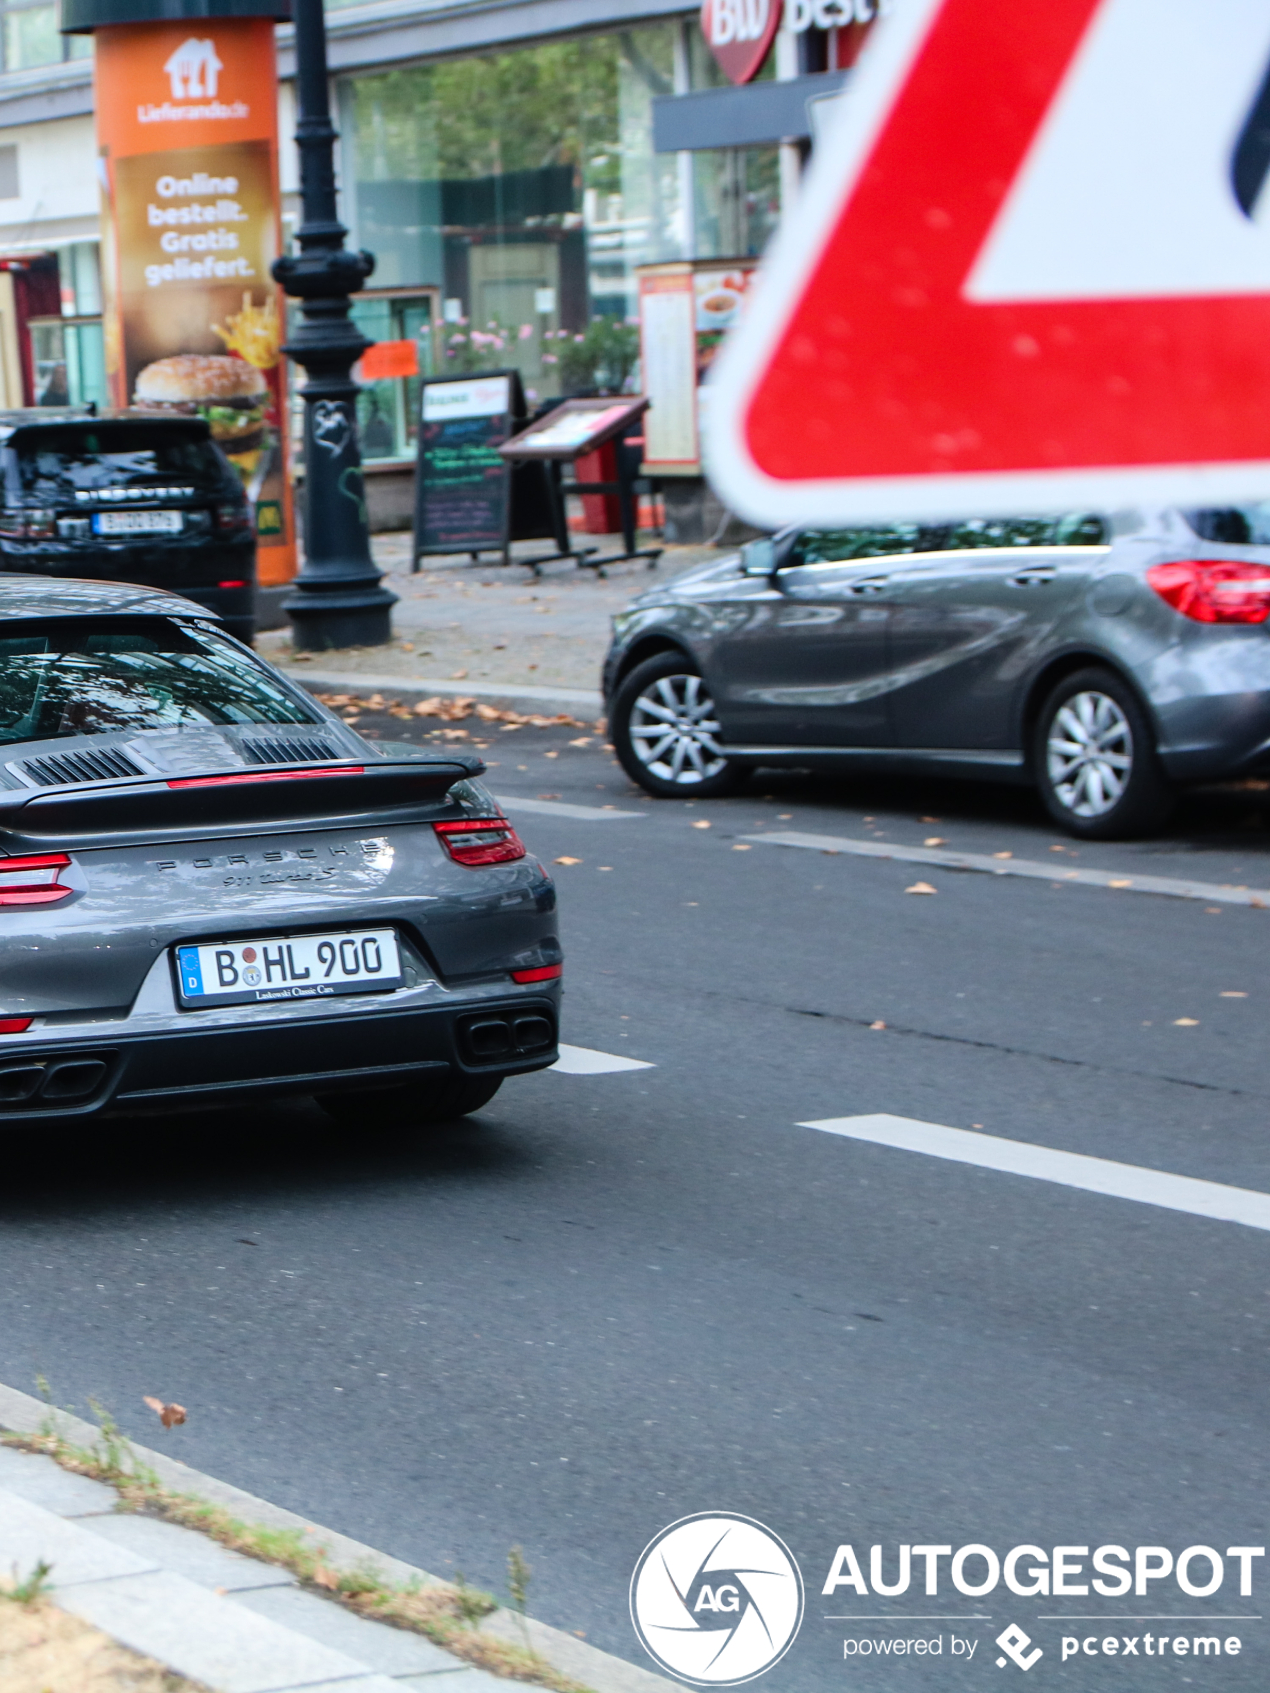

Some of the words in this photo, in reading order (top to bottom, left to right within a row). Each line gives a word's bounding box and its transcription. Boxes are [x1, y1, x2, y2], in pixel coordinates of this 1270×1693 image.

[156, 172, 239, 198] Online
[147, 199, 249, 226] bestellt.
[160, 228, 240, 253] Gratis
[144, 255, 256, 287] geliefert.
[156, 842, 381, 872] PORSCHE
[215, 950, 239, 987] B
[262, 943, 310, 983] HL
[317, 937, 382, 978] 900
[188, 977, 198, 989] D
[291, 986, 316, 997] Classic
[316, 984, 335, 994] Cars
